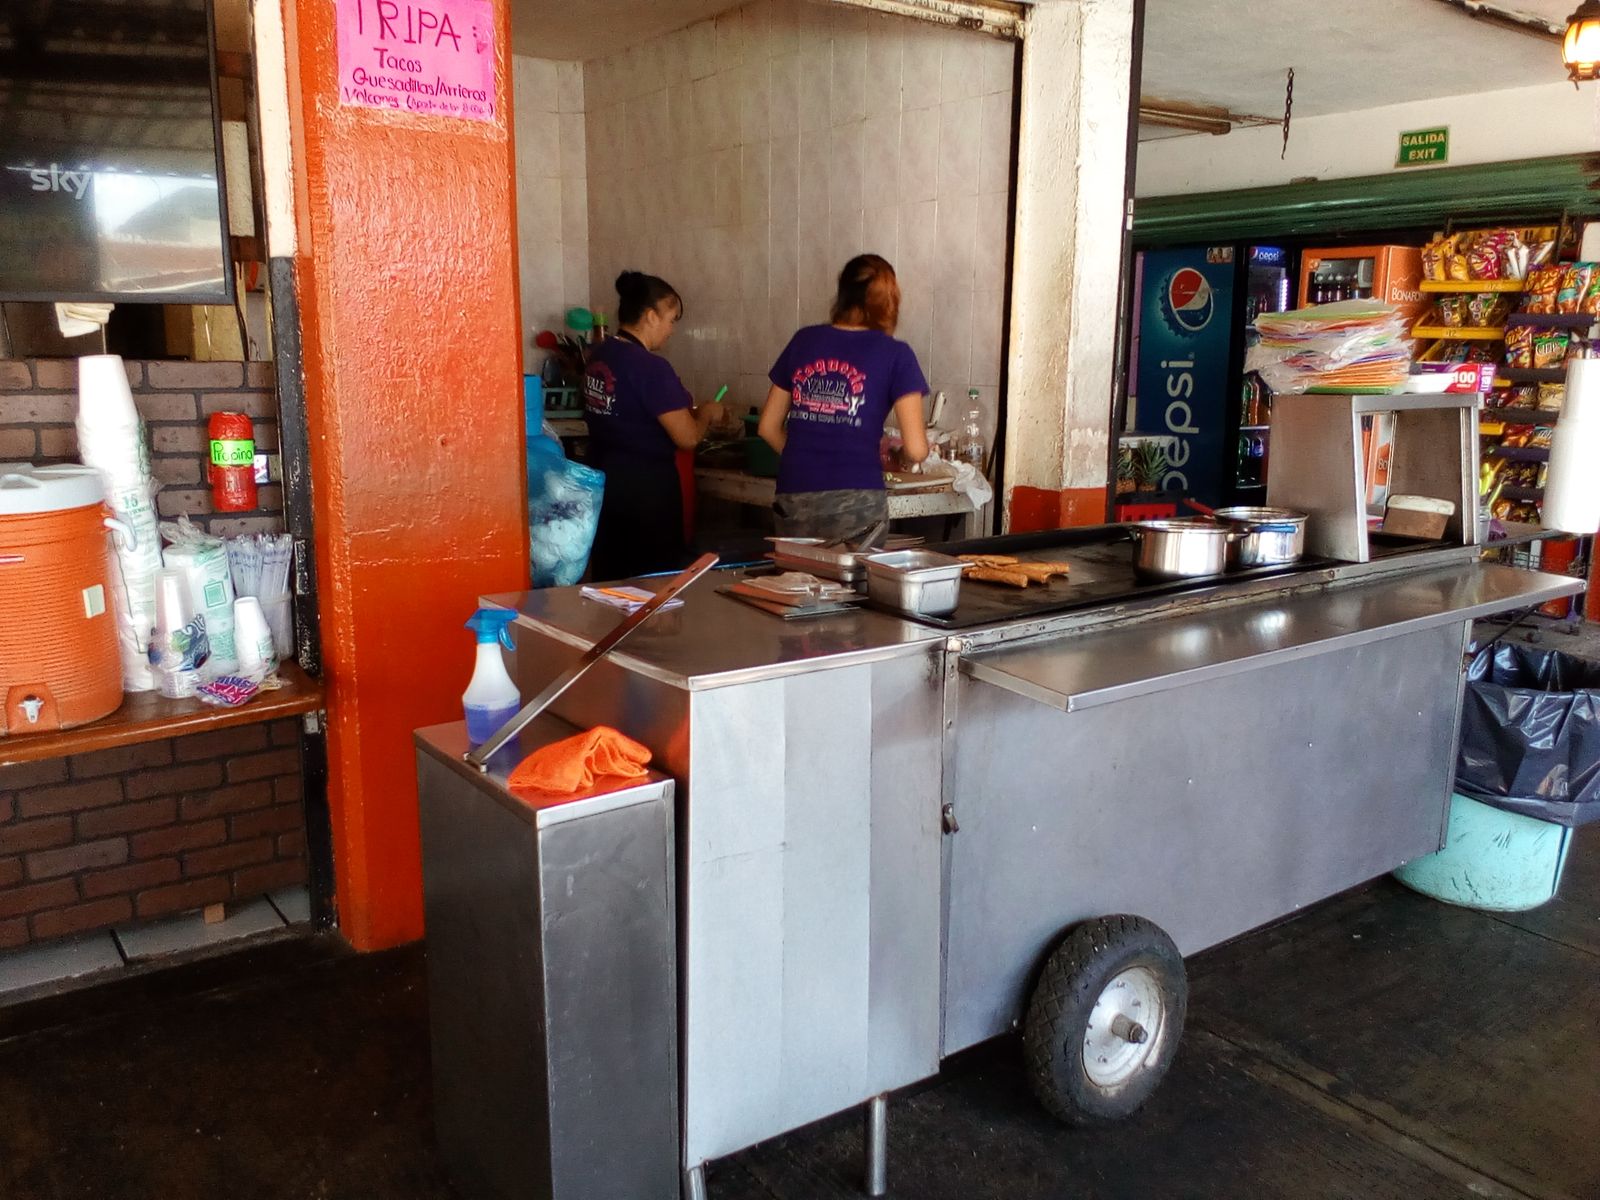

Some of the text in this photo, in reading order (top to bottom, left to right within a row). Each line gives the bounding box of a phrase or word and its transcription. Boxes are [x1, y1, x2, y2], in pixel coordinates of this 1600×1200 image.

[373, 47, 422, 73] Tacos
[1402, 133, 1445, 146] SALIDA
[1409, 148, 1437, 160] EXIT
[30, 163, 92, 199] sky
[1259, 250, 1280, 263] pepsi
[213, 441, 253, 465] Propina
